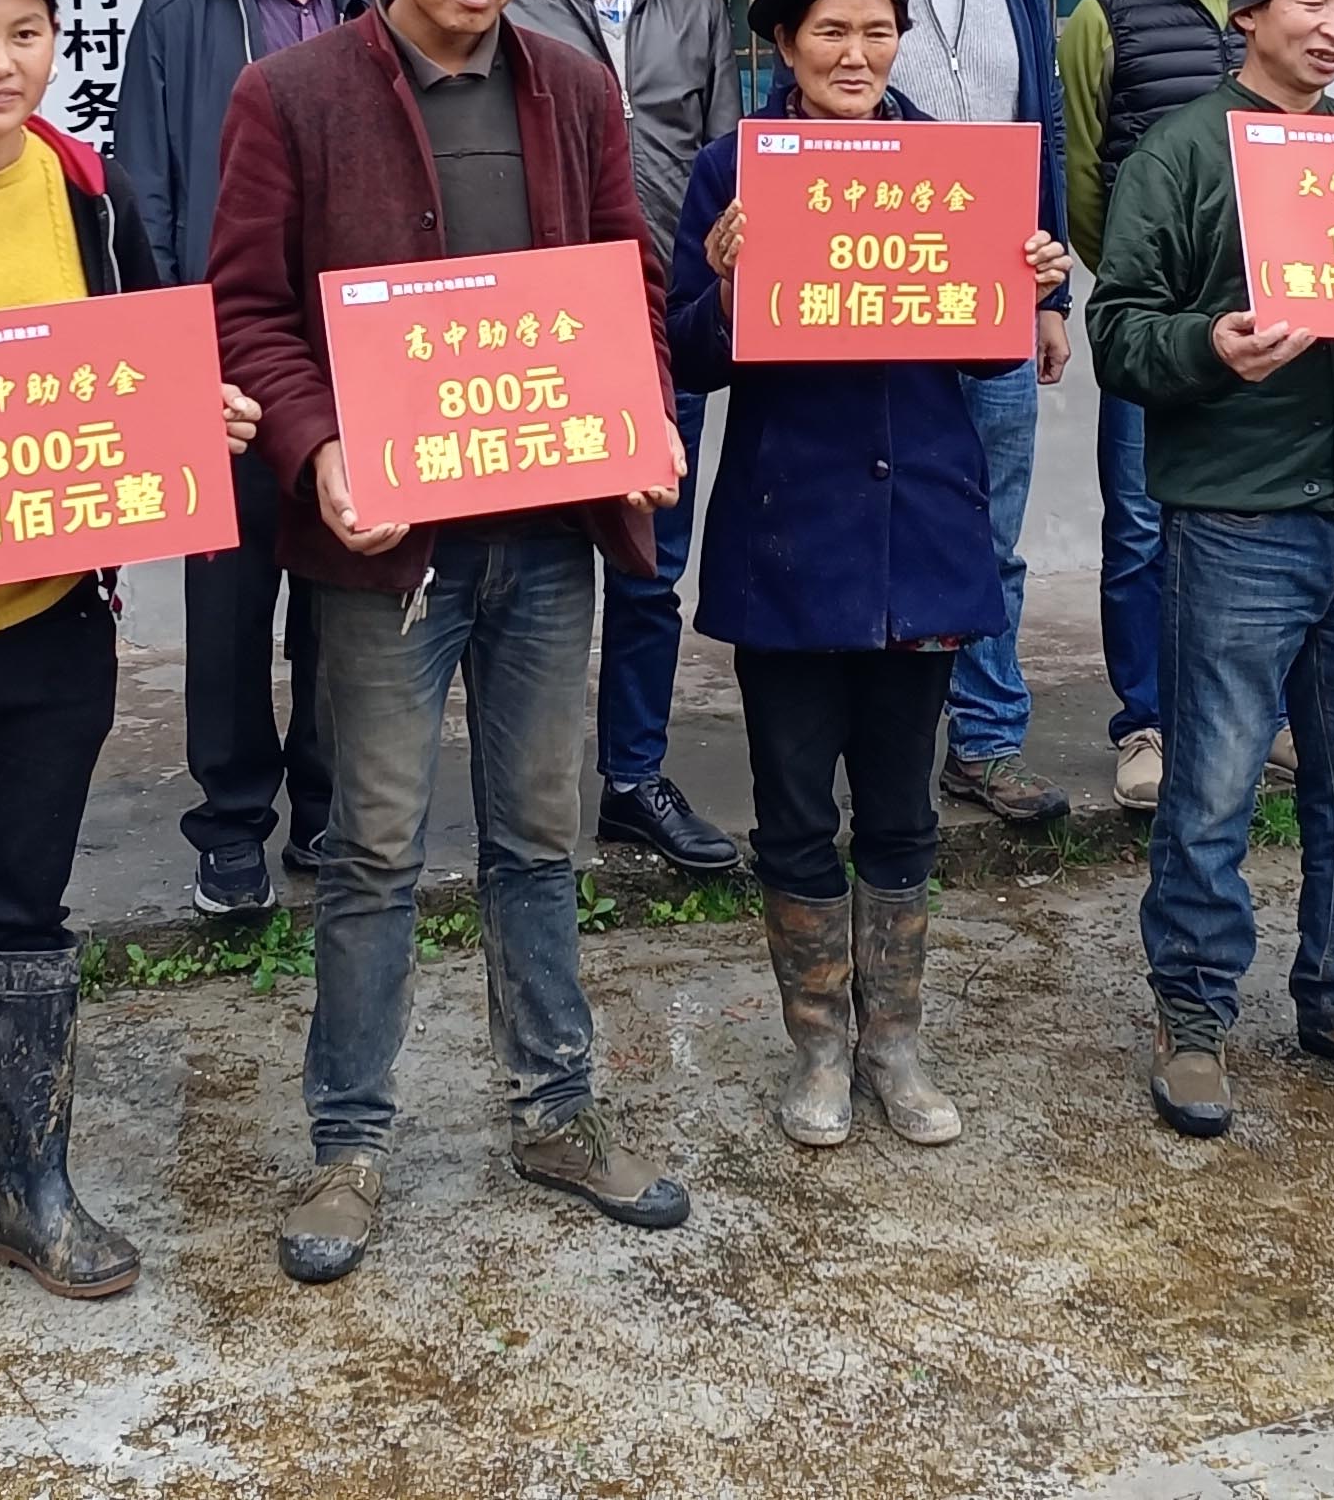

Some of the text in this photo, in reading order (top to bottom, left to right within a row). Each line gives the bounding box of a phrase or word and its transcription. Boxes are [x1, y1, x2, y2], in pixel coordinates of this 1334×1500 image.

[806, 178, 975, 213] 高中助学金
[829, 233, 950, 274] 800元
[404, 309, 585, 361] 高中助学金
[438, 365, 570, 420] 800元
